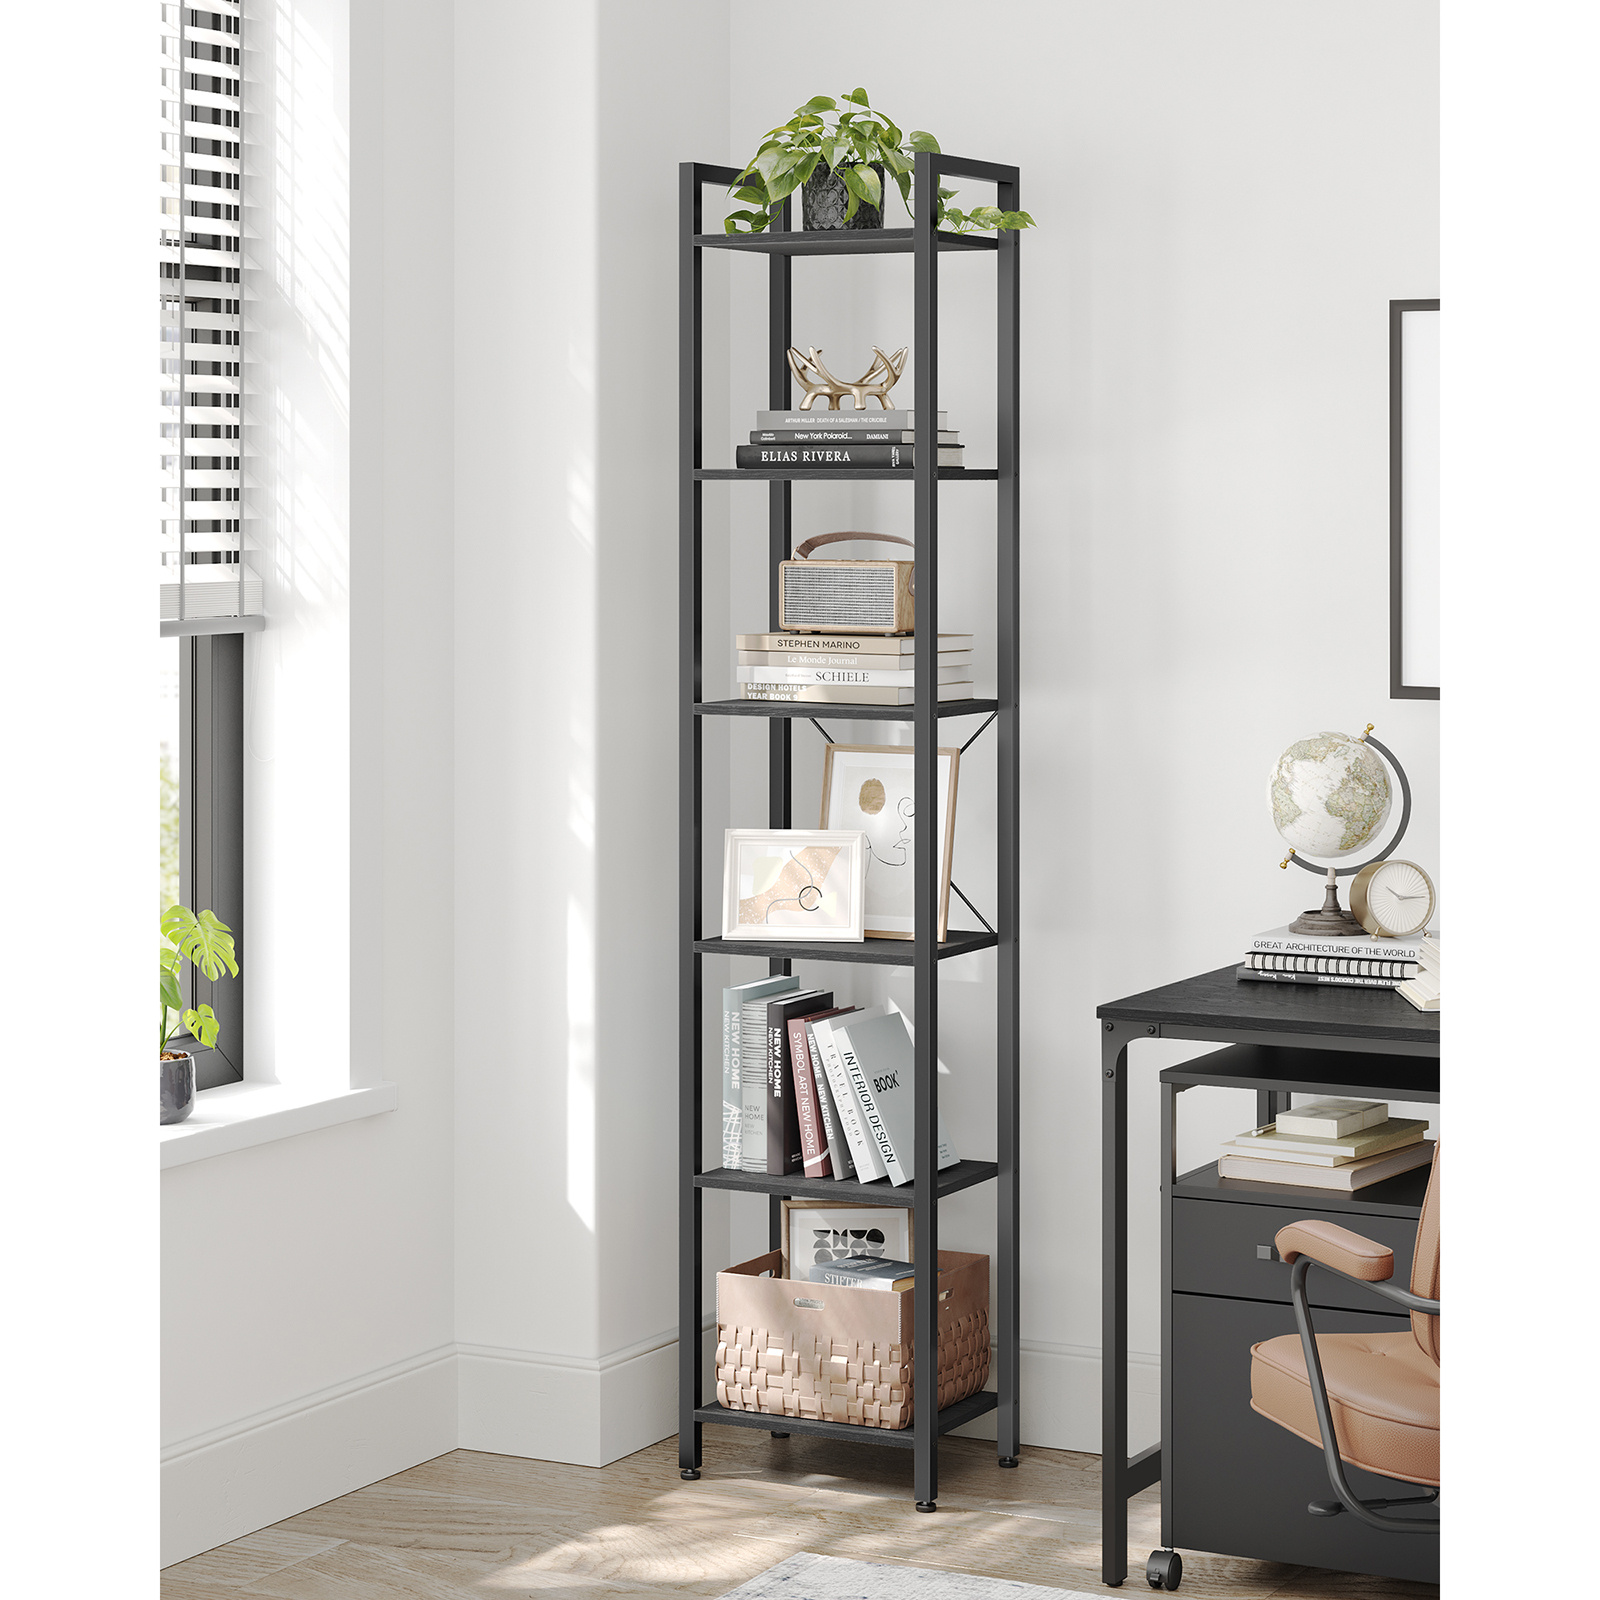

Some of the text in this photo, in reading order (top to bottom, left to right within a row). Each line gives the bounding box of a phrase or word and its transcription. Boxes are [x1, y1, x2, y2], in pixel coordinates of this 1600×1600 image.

[761, 451, 850, 462] ELIAS RIVERA
[778, 639, 860, 650] STEPHEN MARINO
[798, 656, 826, 664] Monde
[828, 656, 857, 665] Journal
[816, 671, 870, 682] SCHIELE
[1254, 940, 1282, 949] GREAT
[1286, 943, 1350, 954] ARCHITECTURE
[1365, 947, 1381, 955] THE
[1383, 948, 1415, 958] WORLD
[732, 1012, 740, 1089] NEW HOME
[793, 1032, 815, 1155] SYMBOL ART NEW HOME
[807, 1033, 834, 1140] NEW HOME NEW KITCHEN
[827, 1044, 863, 1146] TRAVEL BOOK
[843, 1052, 896, 1163] INTERIOR DESIGN
[824, 1273, 863, 1288] STIFTER
